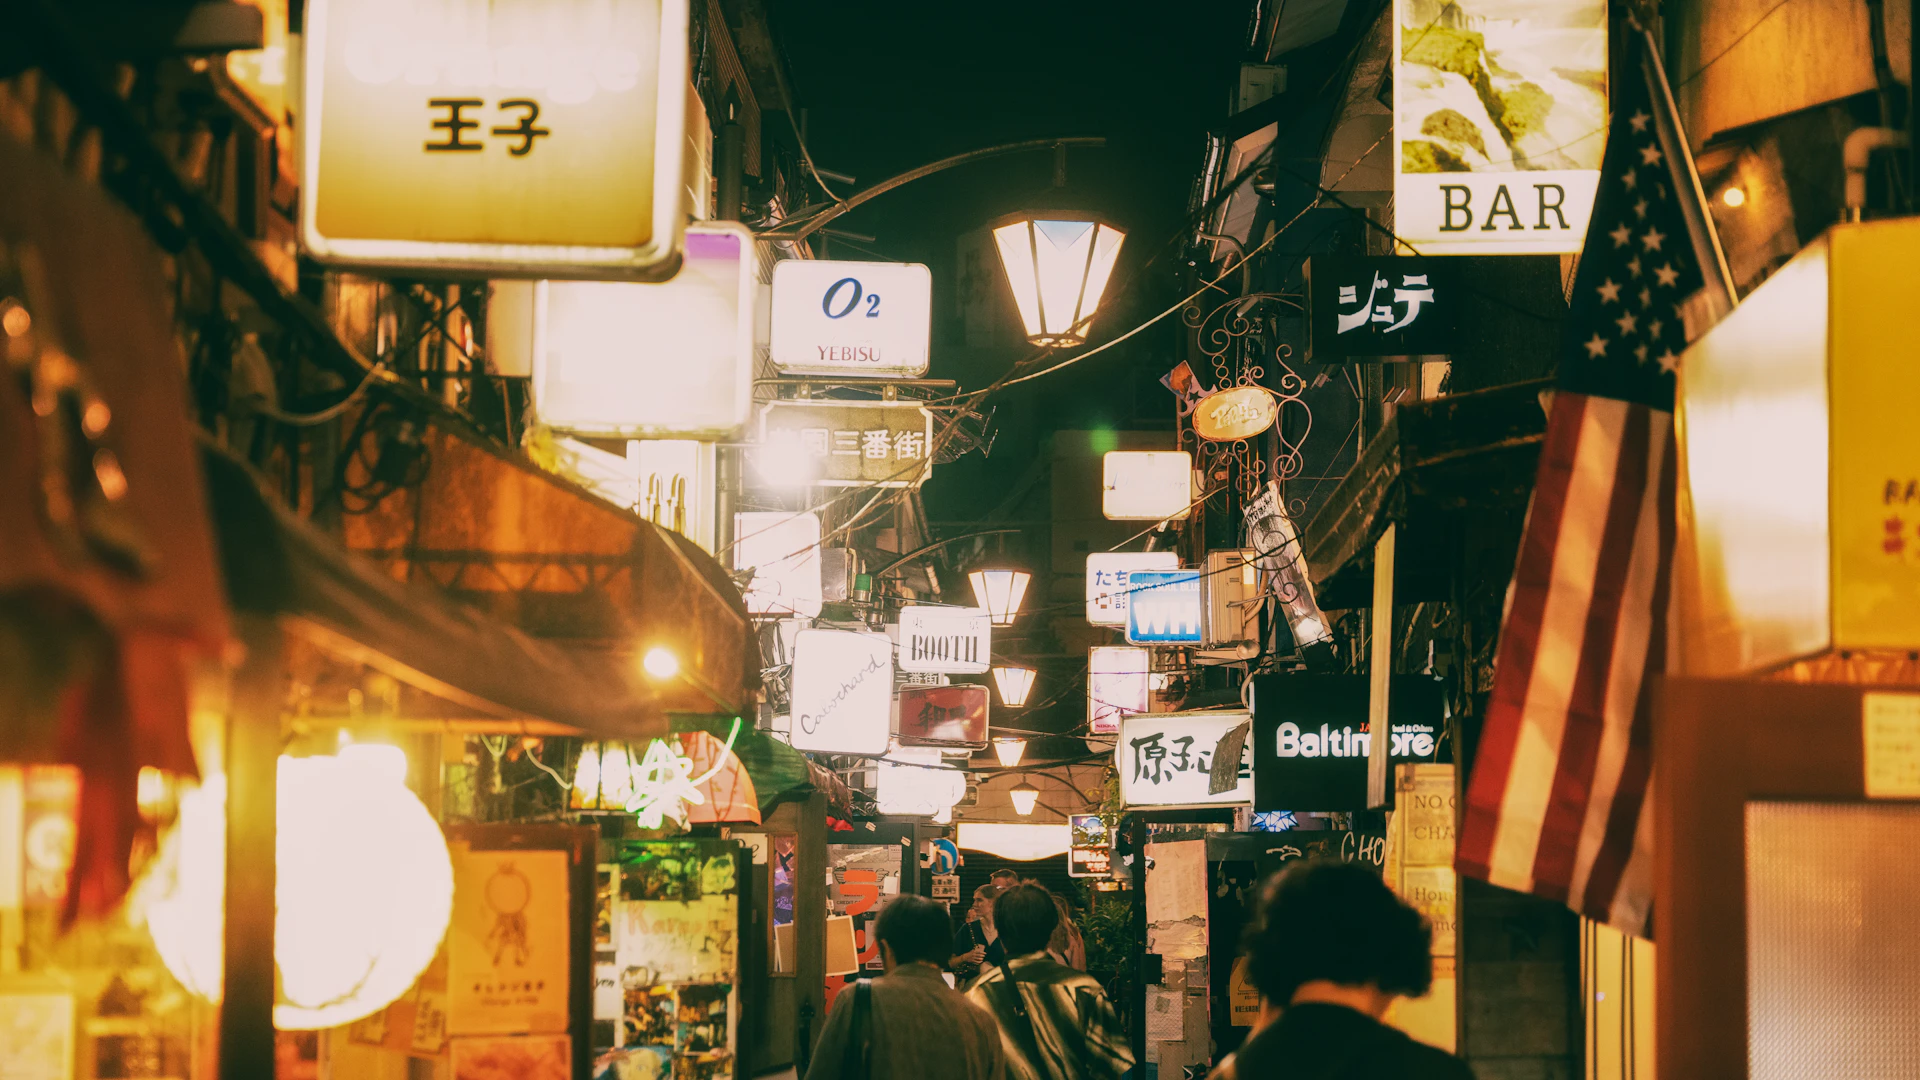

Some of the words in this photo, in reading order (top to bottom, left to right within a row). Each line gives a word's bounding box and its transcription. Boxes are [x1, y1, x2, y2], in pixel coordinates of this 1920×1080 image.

[424, 98, 551, 157] 王子
[1438, 183, 1571, 233] BAR
[1336, 270, 1435, 335] ジュテ
[817, 345, 881, 363] YEBISU
[912, 635, 978, 662] BOOTH
